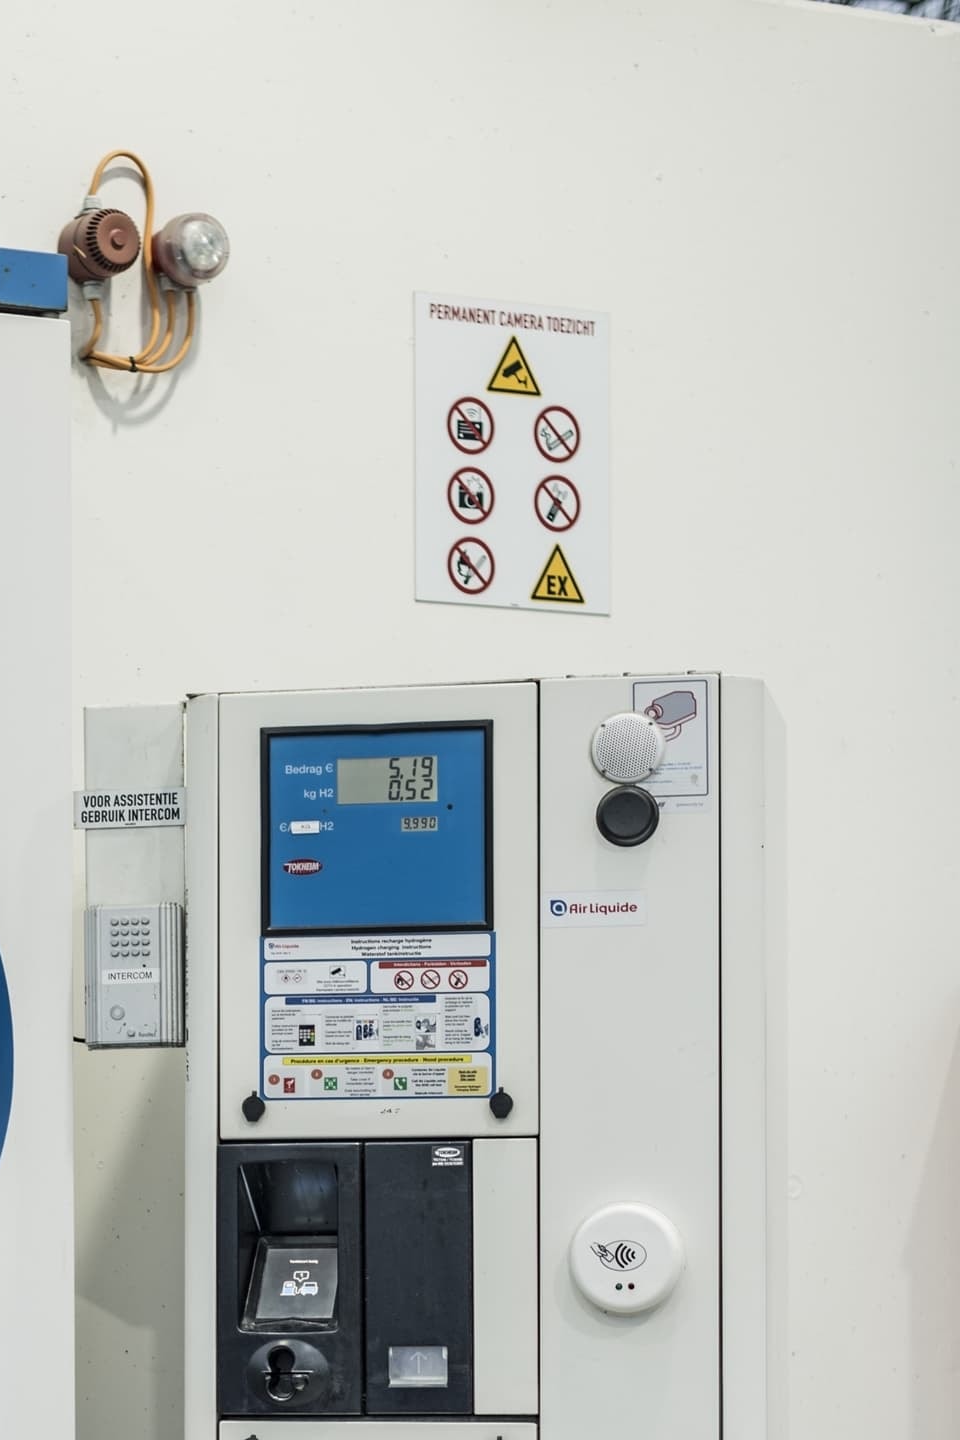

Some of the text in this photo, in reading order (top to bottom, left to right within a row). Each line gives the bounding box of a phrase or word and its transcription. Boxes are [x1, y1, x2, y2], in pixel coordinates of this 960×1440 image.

[429, 303, 595, 336] PERMANENT CAMERA TOEZICHT
[547, 575, 568, 596] EX
[285, 764, 323, 776] Bedrag
[83, 792, 178, 808] VOOR ASSISTENTIE
[304, 788, 334, 801] kg H2
[81, 808, 180, 823] GEBRUIK INTERCOM
[569, 902, 637, 915] Air Liquide
[108, 971, 152, 980] INTERCOM
